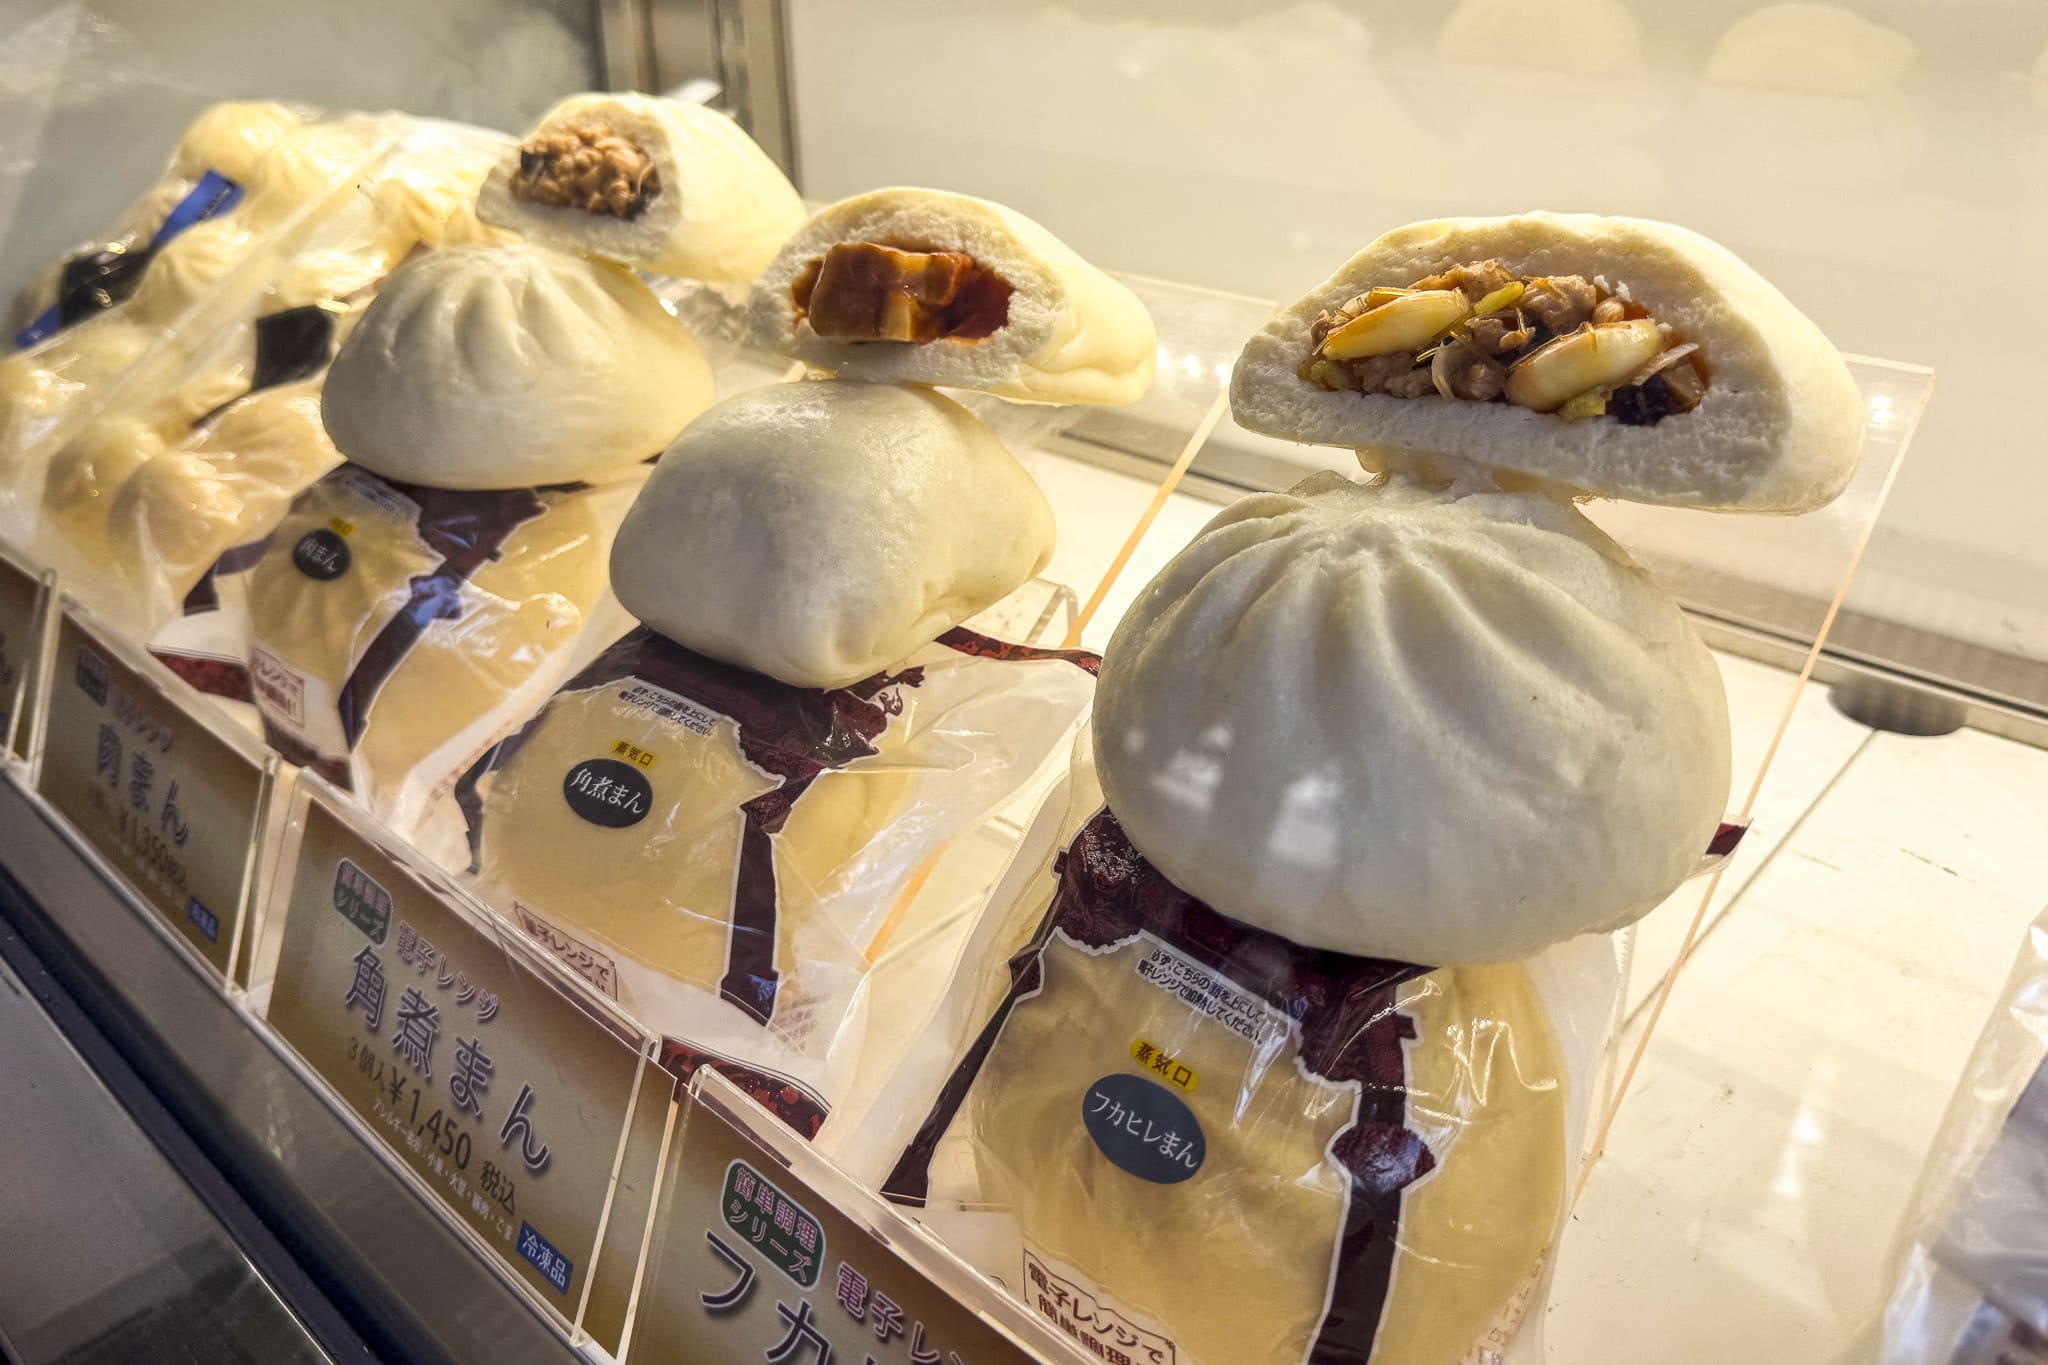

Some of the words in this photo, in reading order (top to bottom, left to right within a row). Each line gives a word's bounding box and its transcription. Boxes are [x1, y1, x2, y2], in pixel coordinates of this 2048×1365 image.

[570, 768, 644, 814] 角煮まん
[398, 919, 499, 1024] 電子レンジ
[344, 944, 551, 1171] 角煮まん
[1135, 1041, 1192, 1087] 蒸気口
[1090, 1090, 1198, 1169] フカヒレまん
[729, 1200, 813, 1283] シリーズ
[733, 1166, 819, 1254] 簡単調理
[522, 1228, 567, 1289] 冷凍品
[701, 1228, 878, 1365] フカ
[836, 1260, 964, 1365] 電子レ
[1028, 1261, 1164, 1365] 電子レンジで
